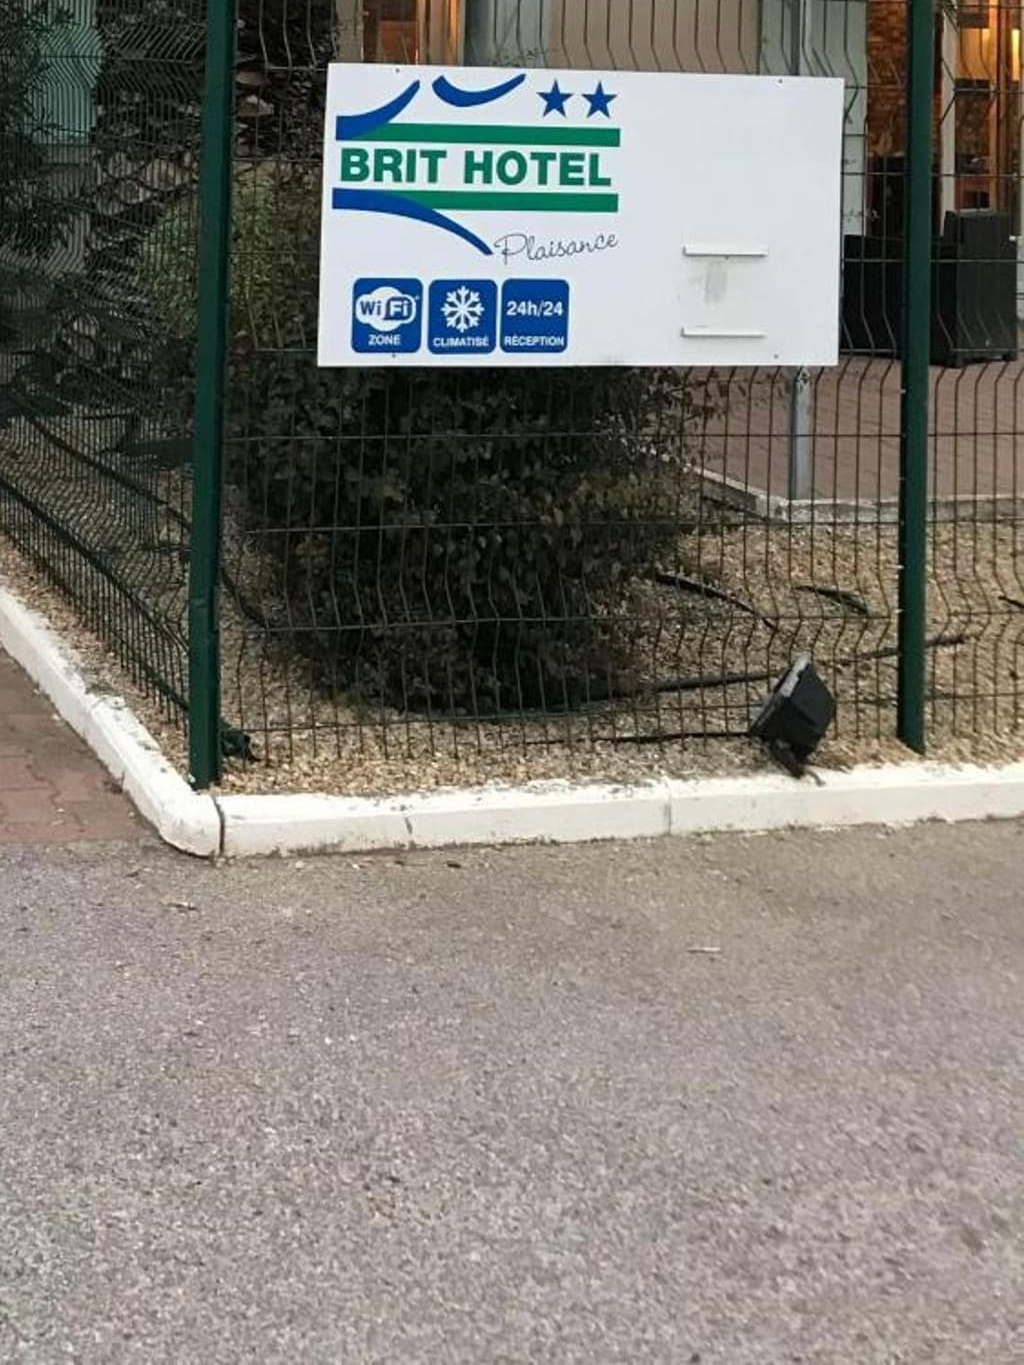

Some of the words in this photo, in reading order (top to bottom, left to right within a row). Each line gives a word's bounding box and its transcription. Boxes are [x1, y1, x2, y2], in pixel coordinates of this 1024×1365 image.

[340, 148, 447, 183] BRIT
[464, 150, 611, 186] HOTEL
[493, 232, 618, 265] Plaisance
[506, 300, 564, 317] 24h/24
[368, 334, 401, 346] ZONE
[433, 336, 490, 347] CLIMATISÉ
[504, 334, 565, 347] RÉCEPTION
